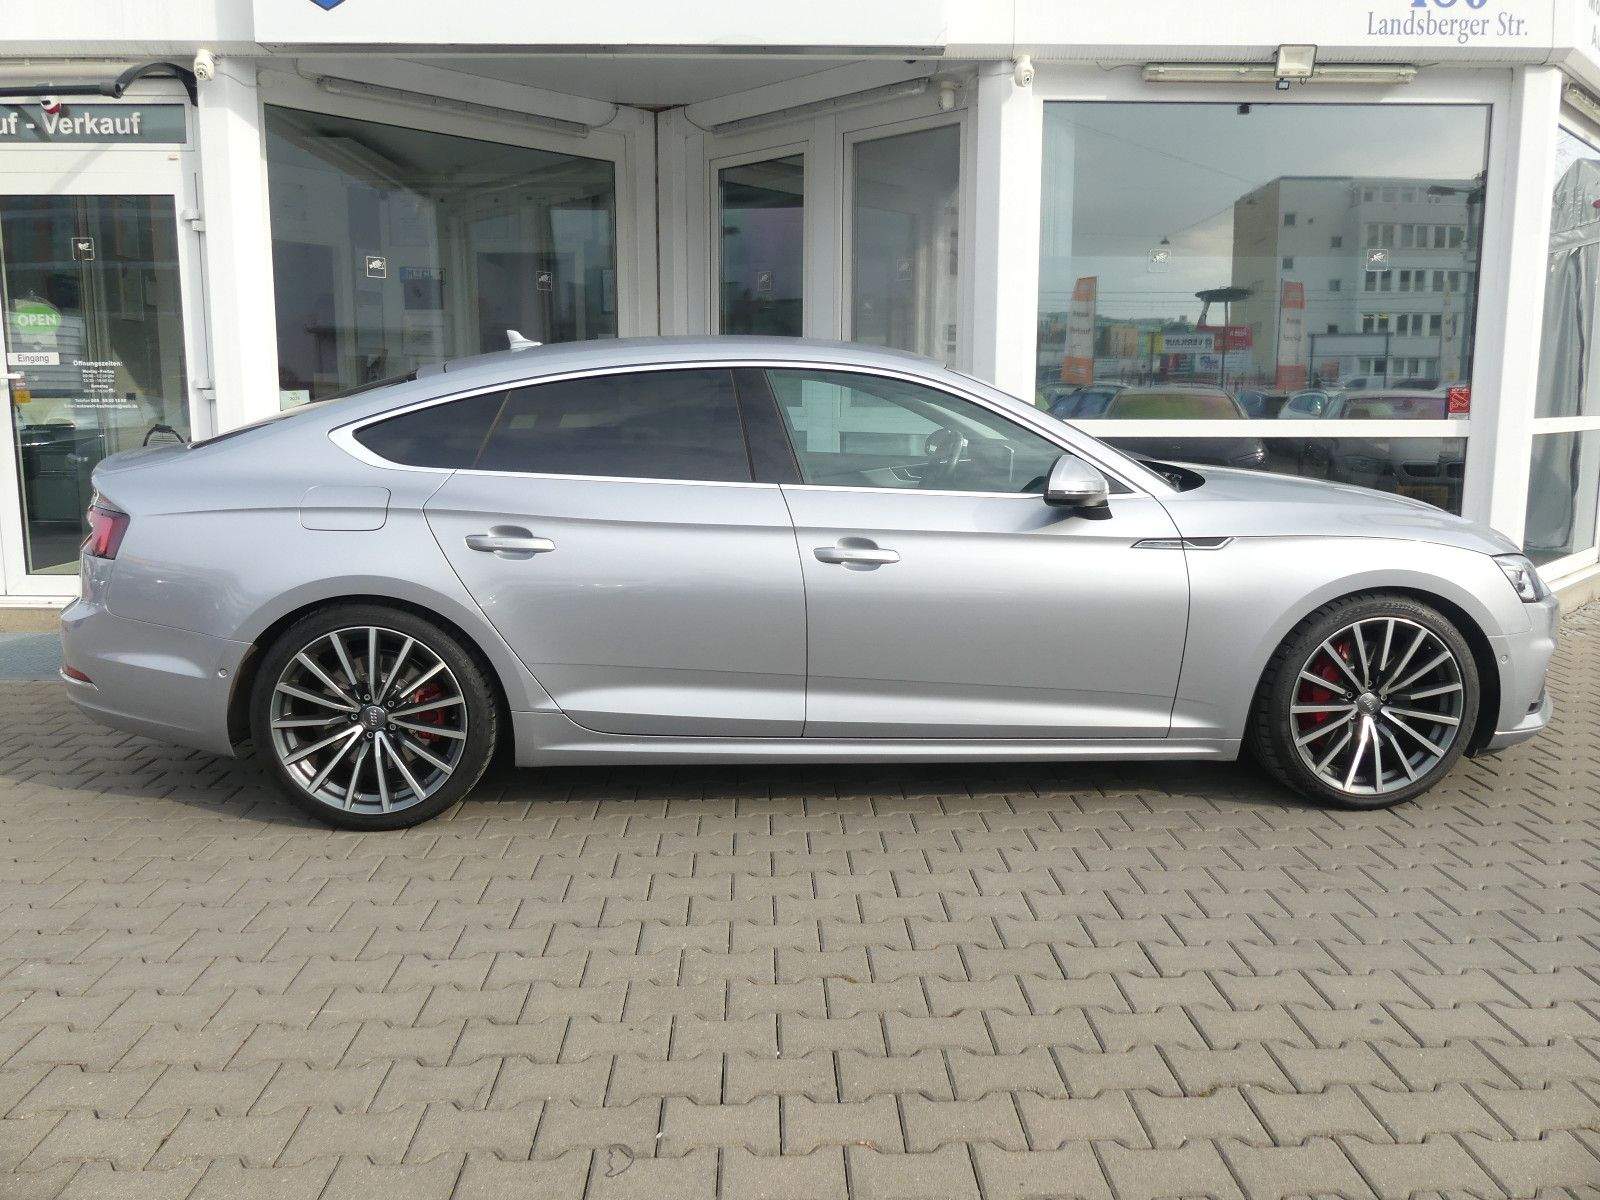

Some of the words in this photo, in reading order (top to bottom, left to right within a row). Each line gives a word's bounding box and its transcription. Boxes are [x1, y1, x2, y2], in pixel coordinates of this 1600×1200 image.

[1367, 10, 1490, 44] Landsberger
[1497, 11, 1528, 37] Str.
[41, 111, 141, 135] Verkauf
[18, 313, 58, 327] OPEN
[17, 354, 50, 364] Eingang
